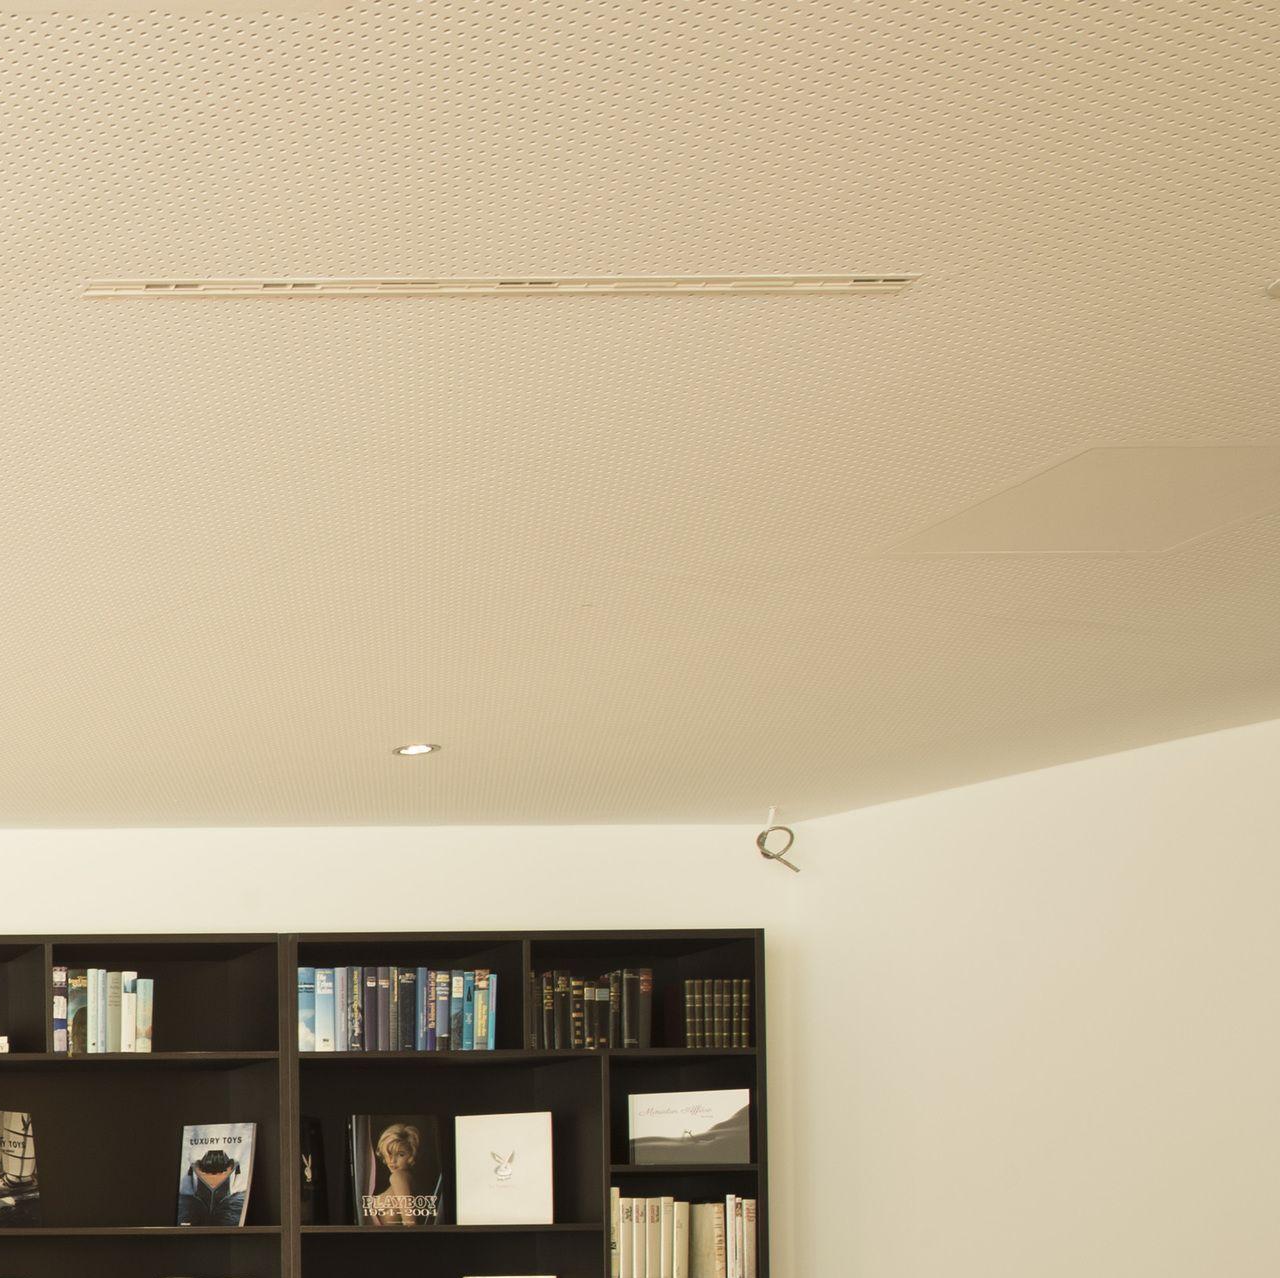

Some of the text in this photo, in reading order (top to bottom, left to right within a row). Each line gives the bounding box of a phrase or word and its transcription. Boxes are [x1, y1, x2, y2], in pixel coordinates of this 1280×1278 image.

[8, 1140, 25, 1148] TOYS
[190, 1136, 242, 1145] LUXURY TOYS
[362, 1195, 438, 1208] PLAYBOY
